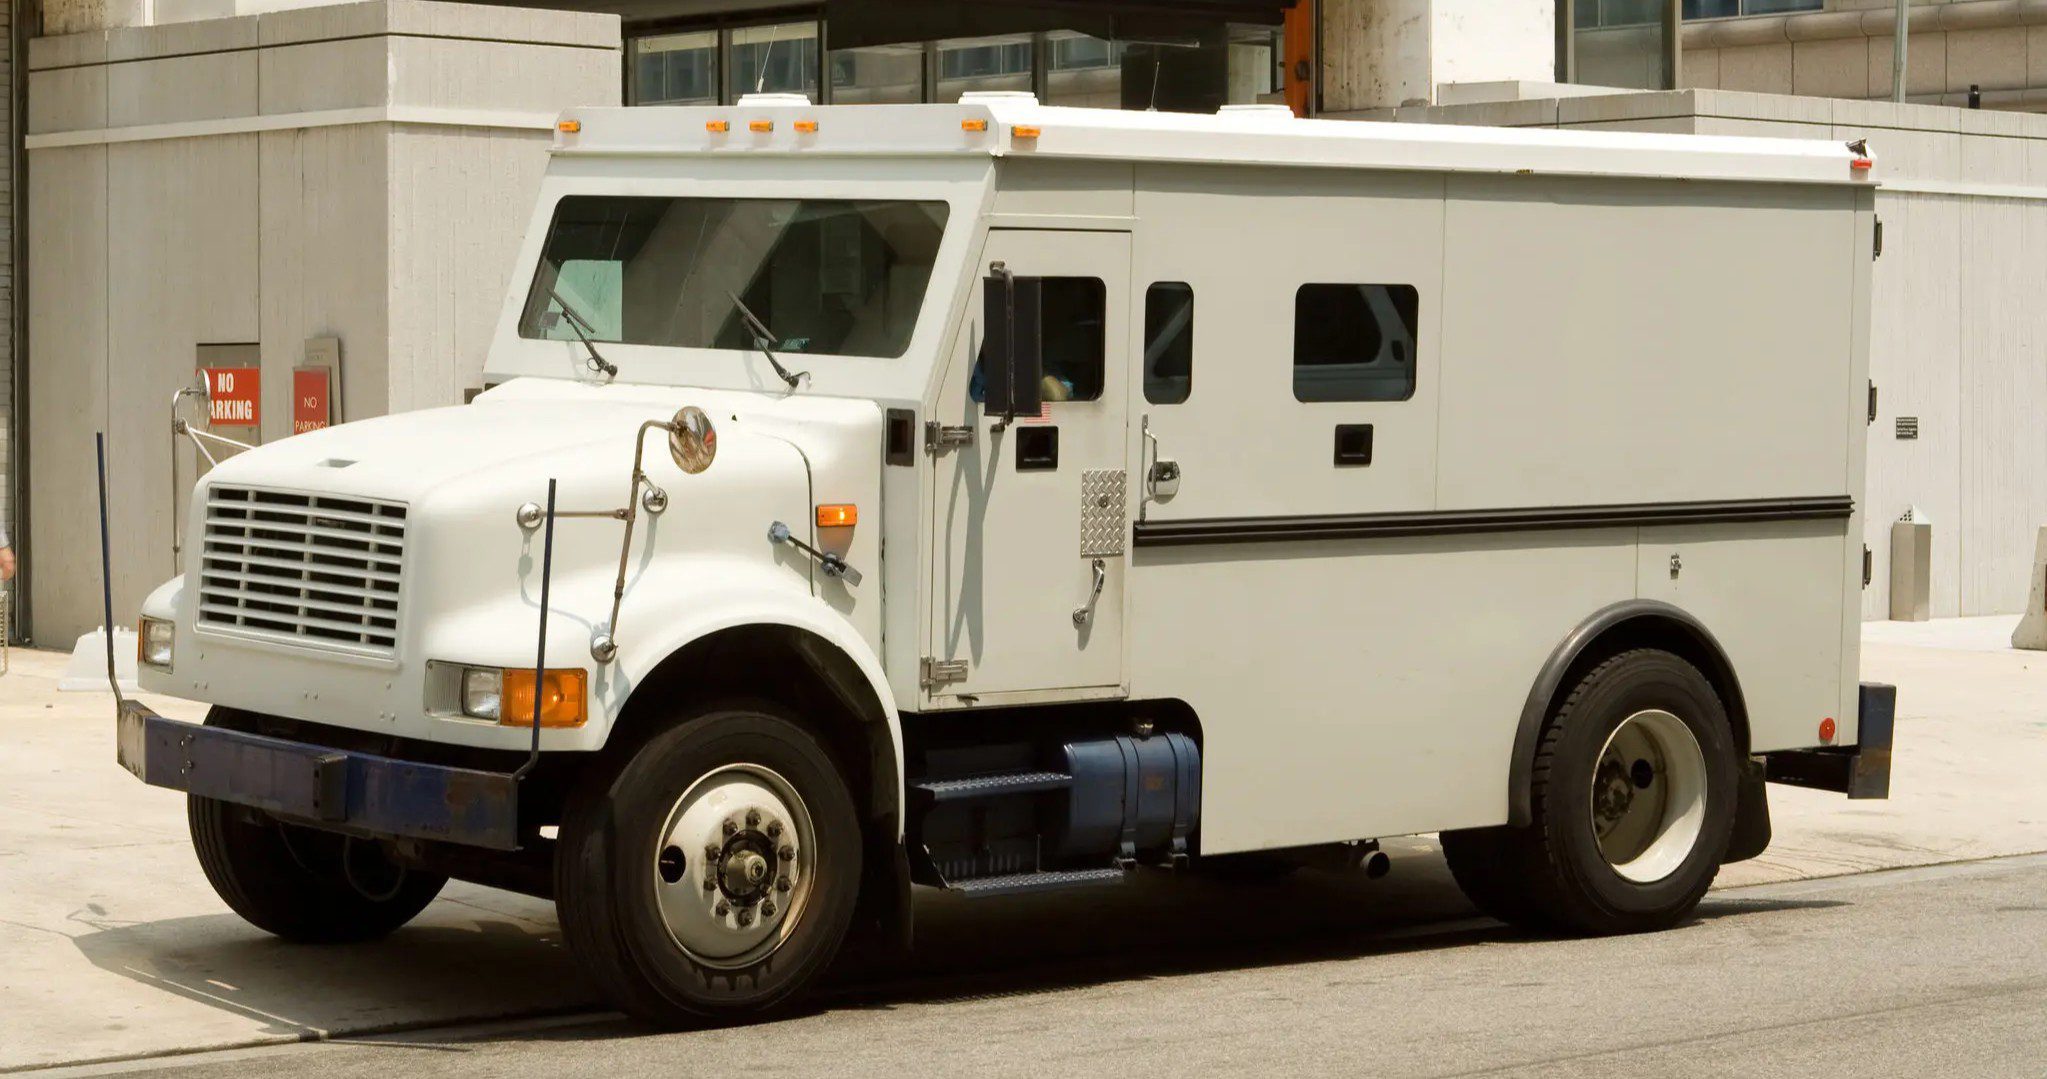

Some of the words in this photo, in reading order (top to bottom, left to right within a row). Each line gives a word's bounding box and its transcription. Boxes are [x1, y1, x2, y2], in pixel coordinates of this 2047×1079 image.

[217, 373, 234, 393] NO
[208, 399, 253, 420] ARKING
[303, 396, 317, 408] NO
